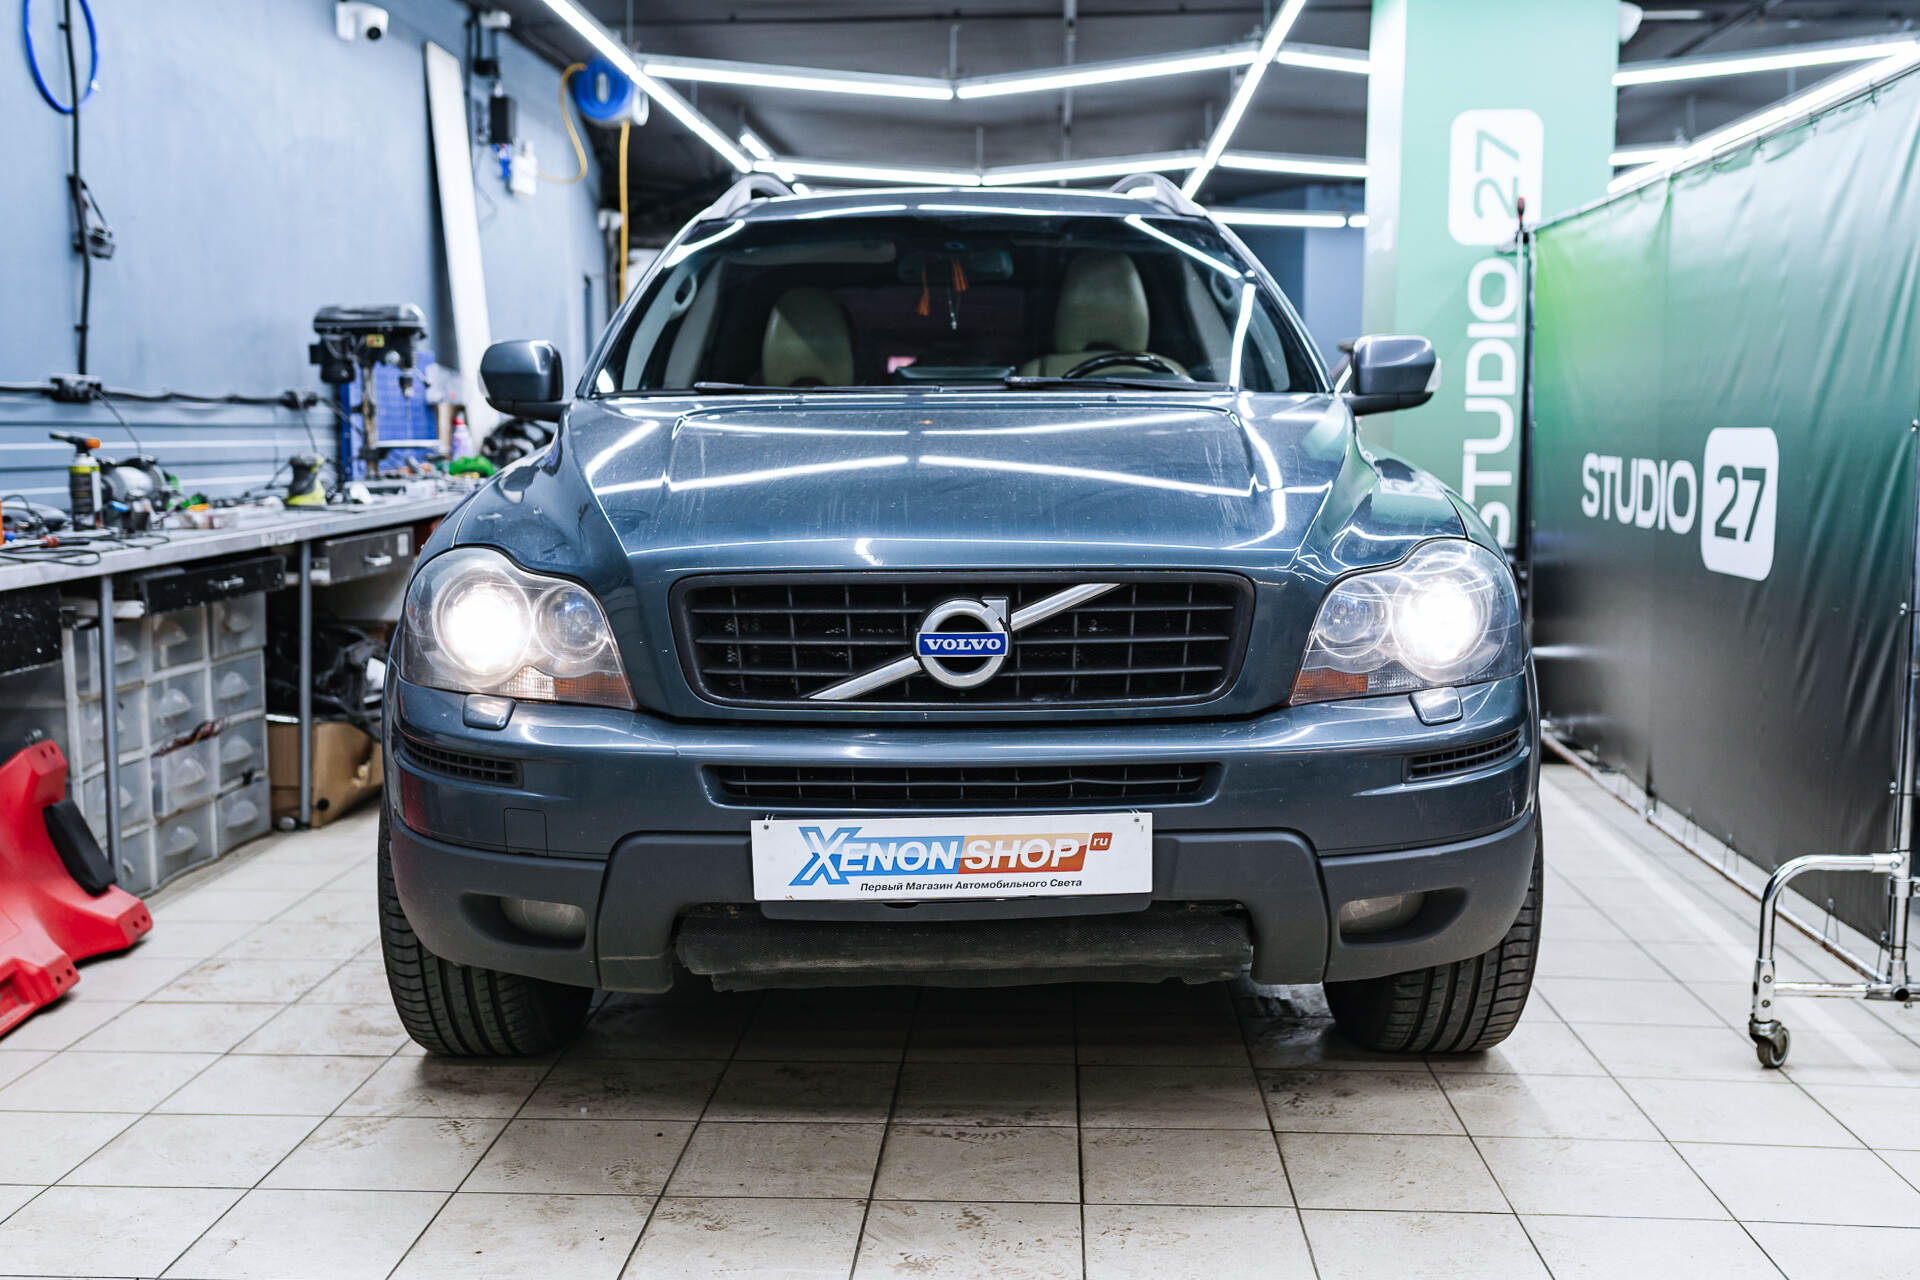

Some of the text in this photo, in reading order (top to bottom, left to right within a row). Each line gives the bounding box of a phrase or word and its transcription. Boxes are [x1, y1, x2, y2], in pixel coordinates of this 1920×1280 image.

[1473, 130, 1520, 220] 27
[1581, 452, 1767, 542] STUDIO 27
[924, 638, 1001, 650] VOLVO
[1093, 836, 1107, 847] ru
[860, 878, 1082, 892] Первый Магазин Автомобильного Света
